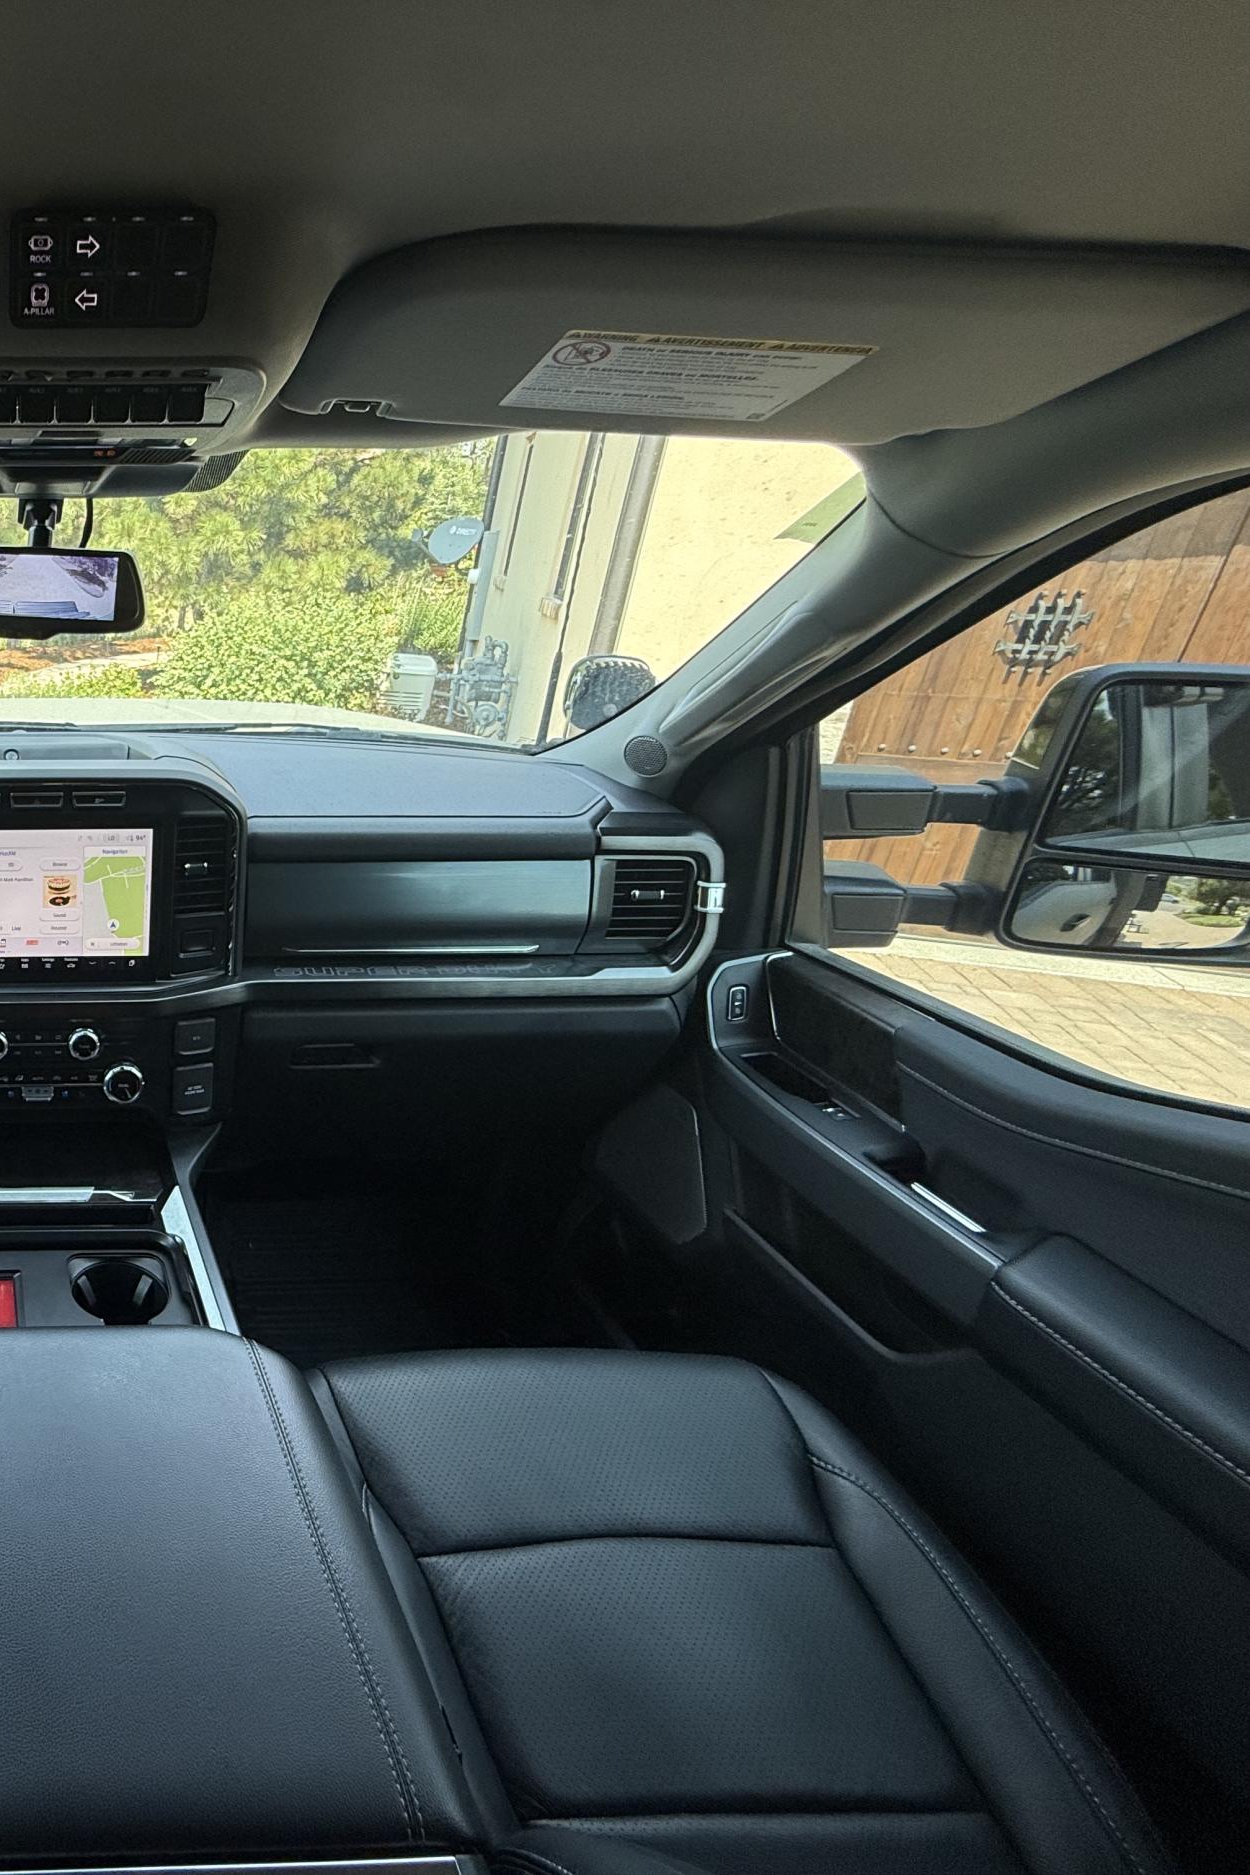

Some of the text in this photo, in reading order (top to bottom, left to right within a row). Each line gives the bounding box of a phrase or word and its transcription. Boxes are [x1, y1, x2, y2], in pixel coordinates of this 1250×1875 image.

[29, 254, 52, 264] ROCK
[23, 307, 55, 316] A-PILLAR
[582, 331, 638, 342] WARNING
[662, 336, 765, 349] AVERTISSEMENT
